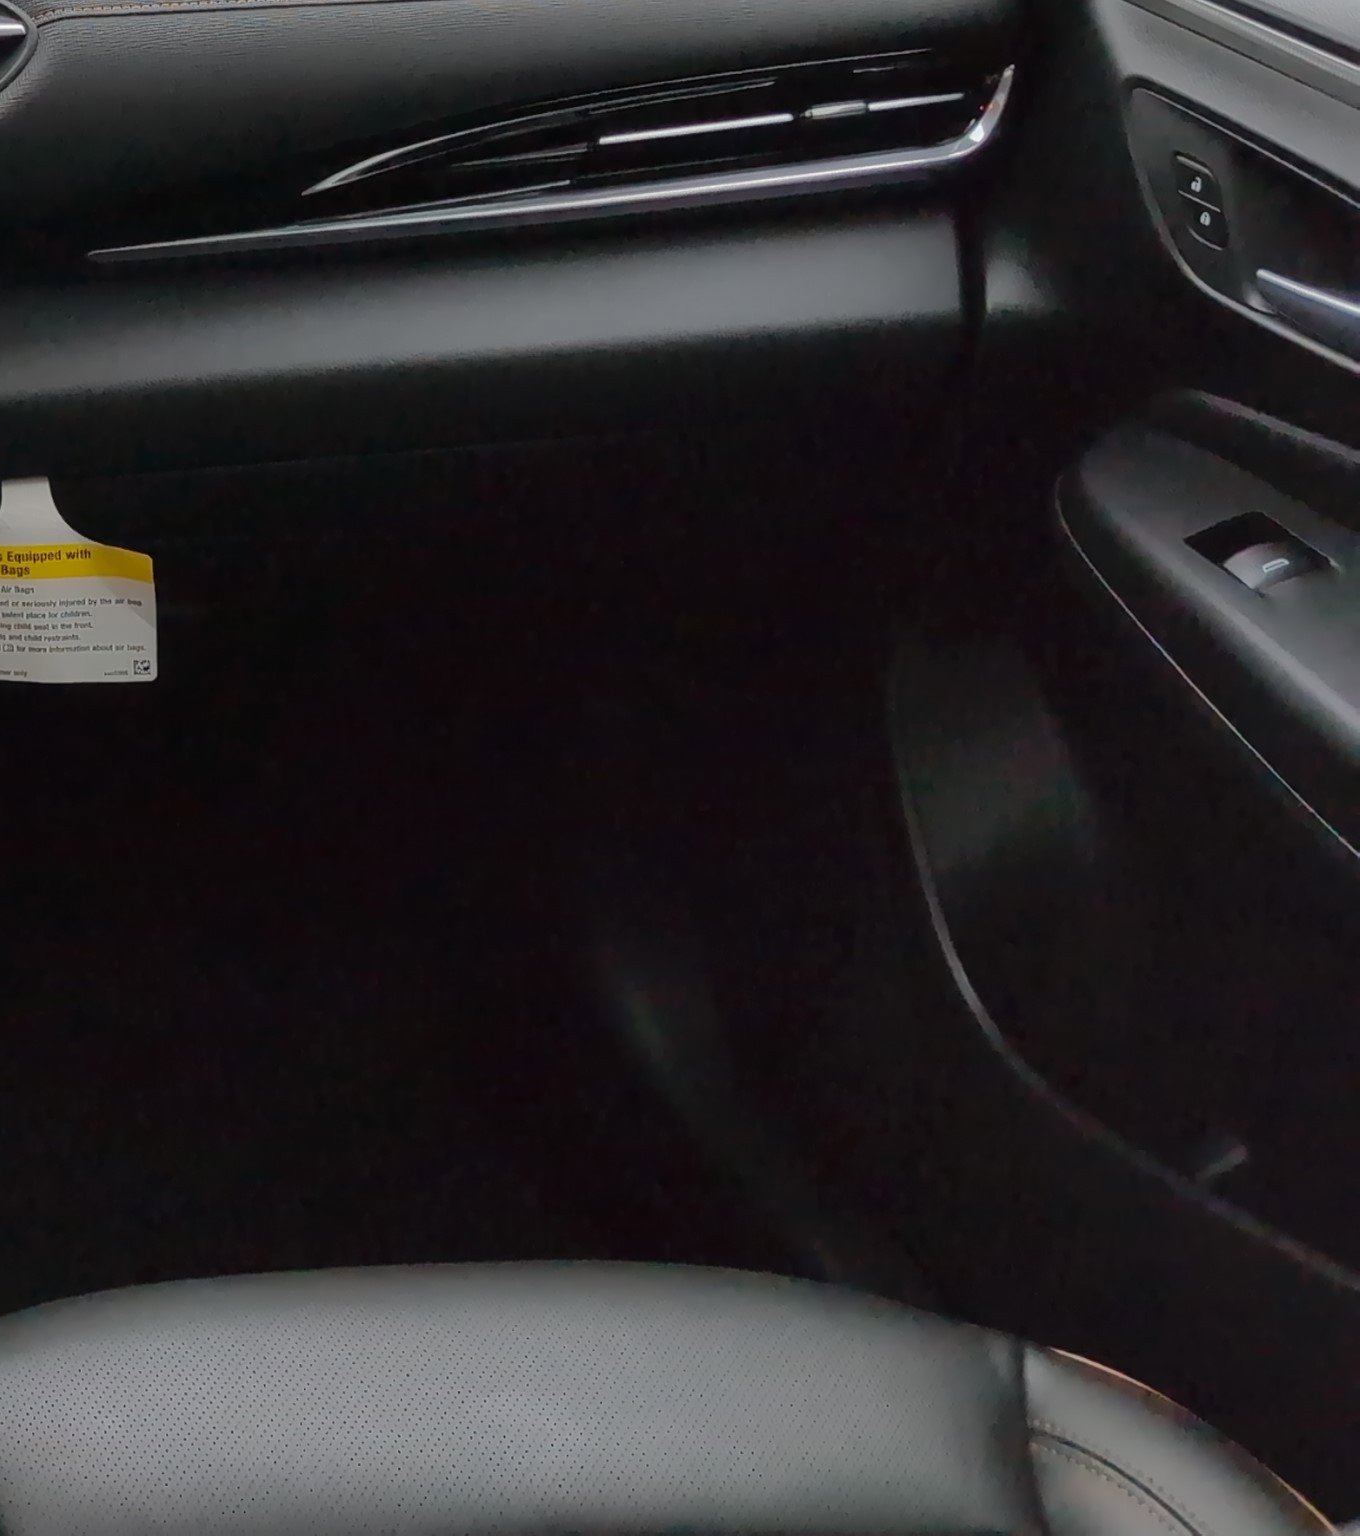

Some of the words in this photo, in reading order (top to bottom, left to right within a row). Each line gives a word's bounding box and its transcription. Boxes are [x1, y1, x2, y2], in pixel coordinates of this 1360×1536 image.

[7, 549, 62, 564] Equipped
[65, 548, 91, 560] with
[1, 565, 31, 577] Bags
[1, 585, 12, 593] Air
[58, 597, 86, 607] injured
[100, 597, 112, 605] the
